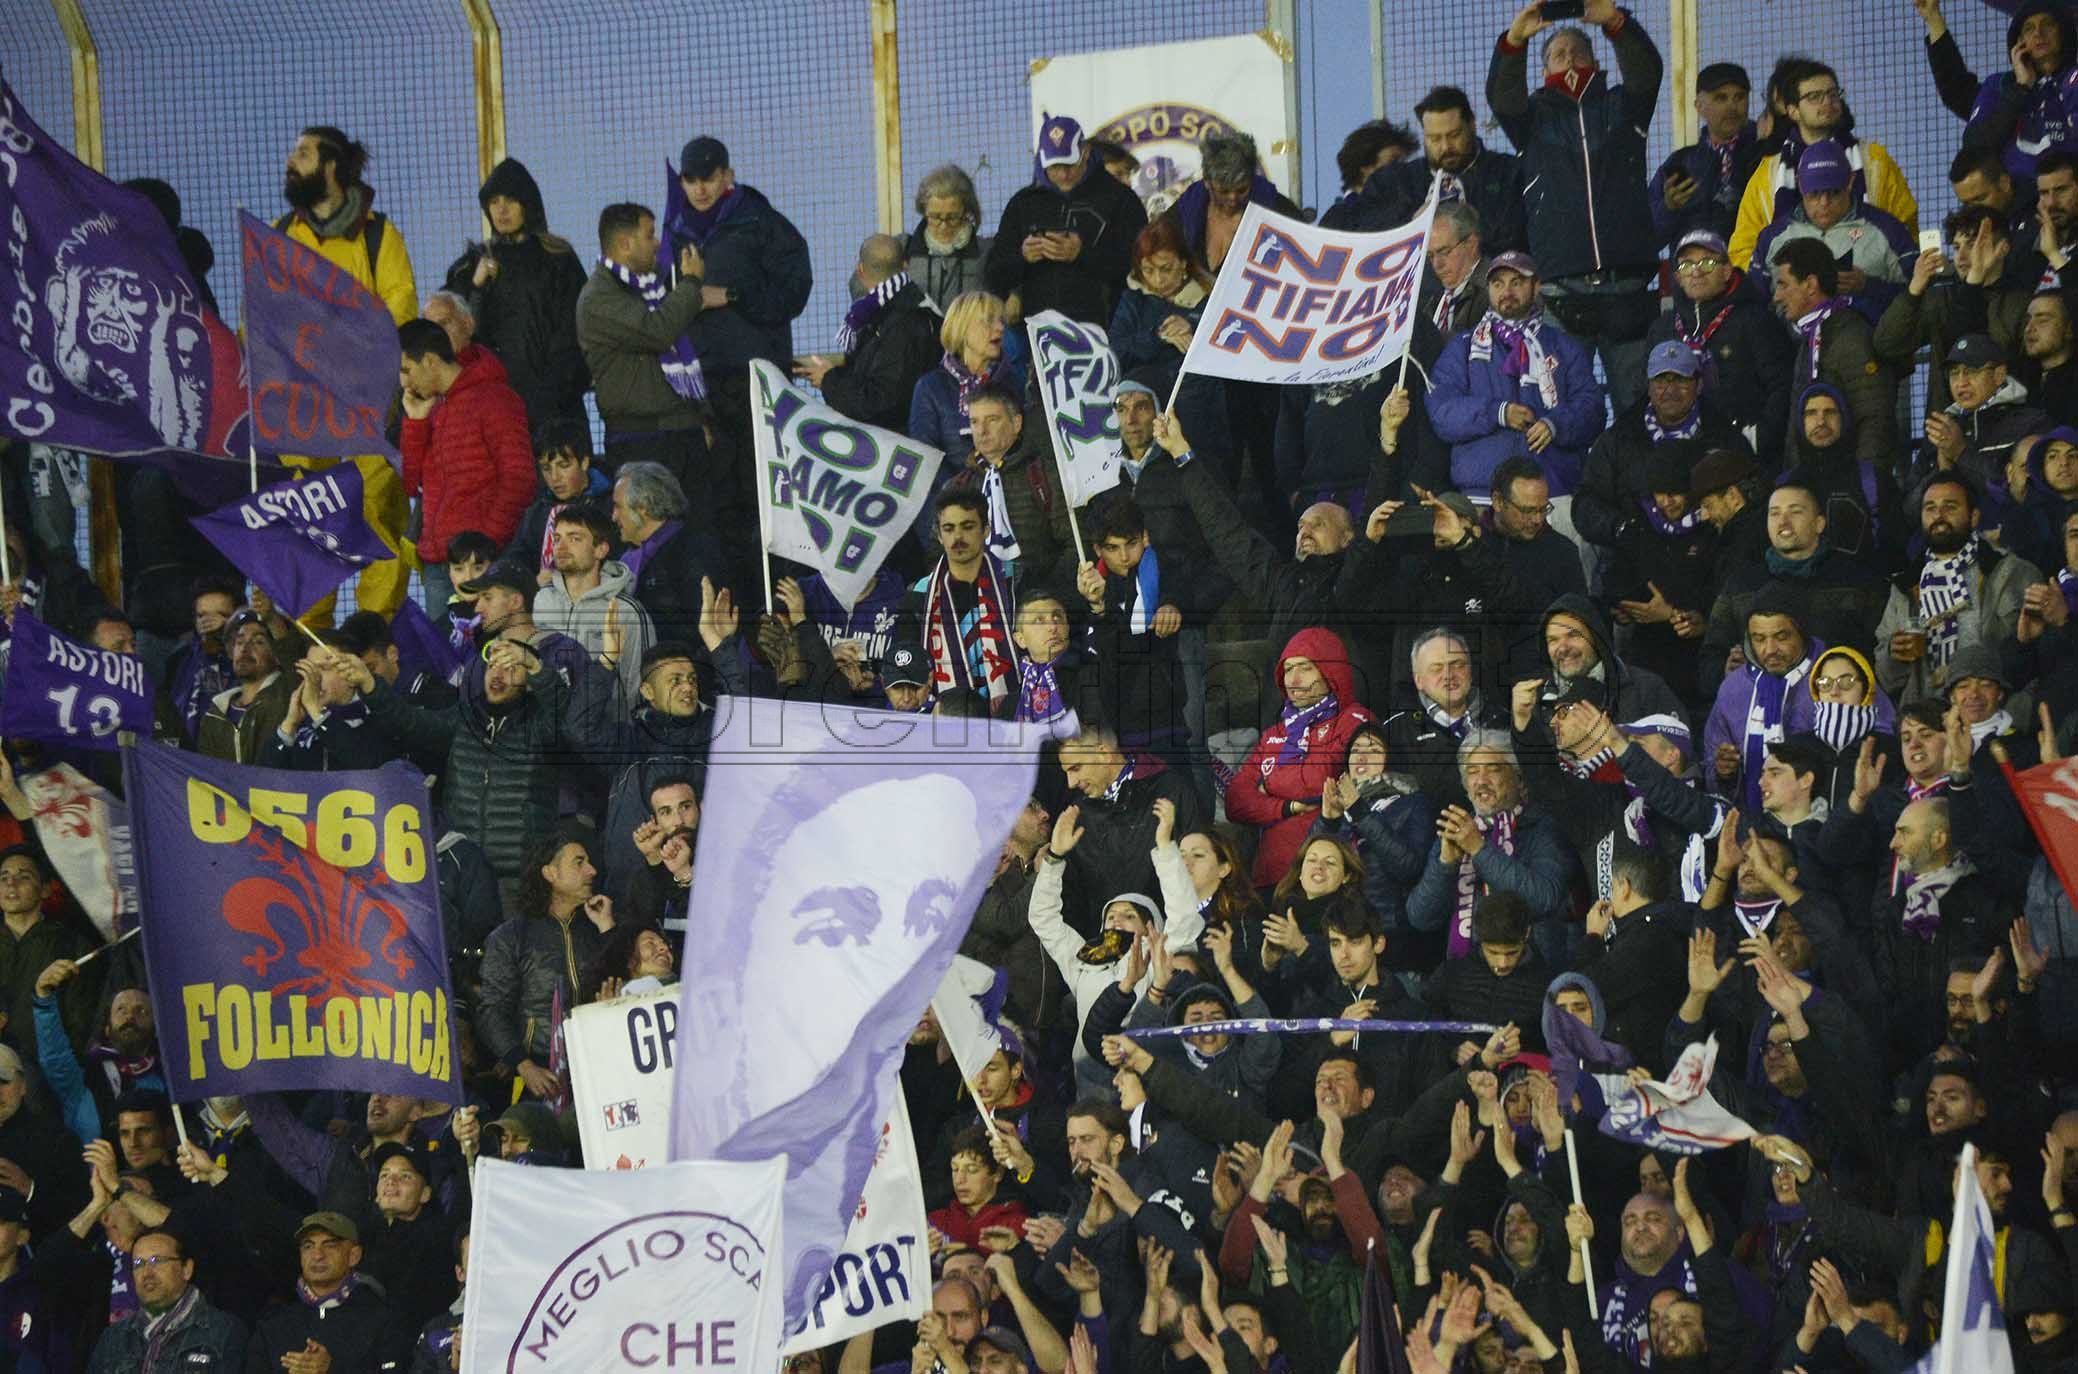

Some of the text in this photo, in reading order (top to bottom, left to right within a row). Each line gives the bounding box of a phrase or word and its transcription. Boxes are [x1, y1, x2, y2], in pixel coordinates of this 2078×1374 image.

[48, 634, 145, 698] ASTORI
[48, 684, 122, 737] 13
[186, 776, 427, 884] 0566
[182, 982, 450, 1082] FOLLONICA
[524, 1229, 685, 1362] MEGLIO
[790, 1235, 916, 1336] PORT
[620, 1320, 736, 1368] CHE
